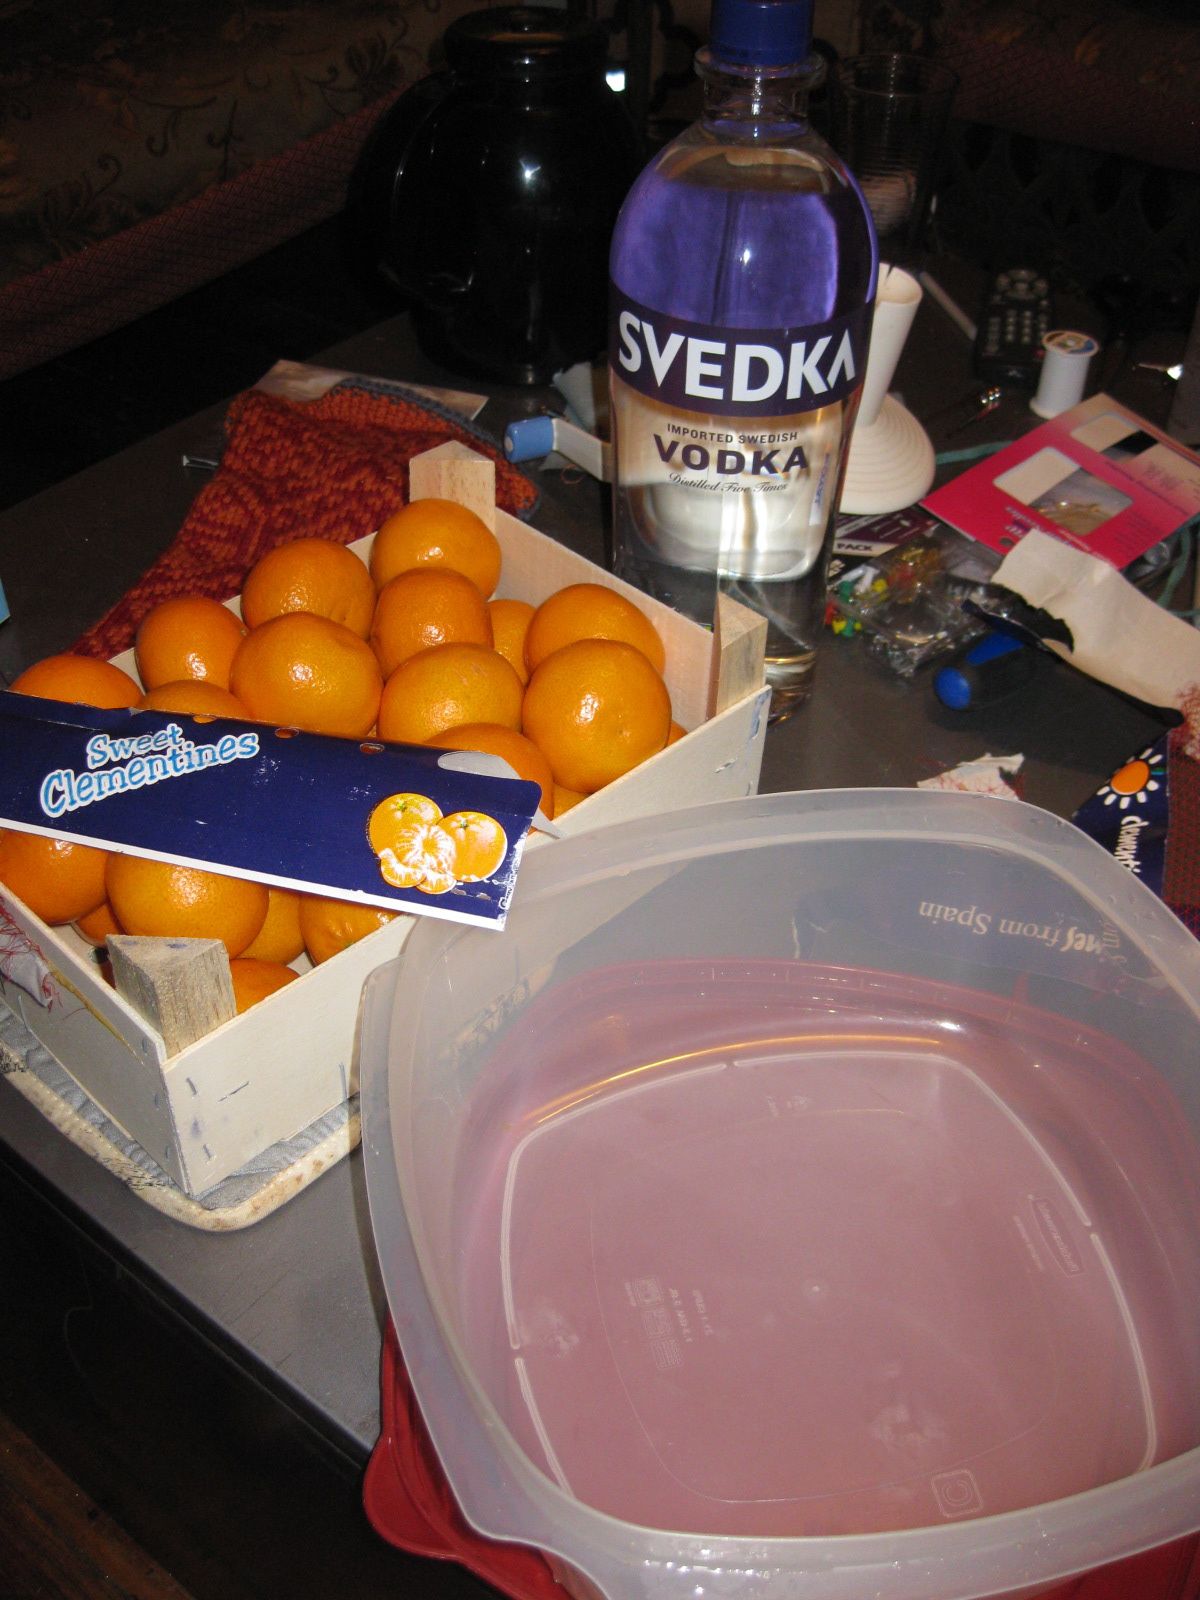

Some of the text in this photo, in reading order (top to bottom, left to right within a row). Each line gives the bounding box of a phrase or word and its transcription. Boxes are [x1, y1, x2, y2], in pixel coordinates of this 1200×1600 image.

[618, 310, 856, 402] SVEDKA
[667, 423, 798, 444] IMPORTED SWEDISH
[653, 433, 809, 475] VODKA
[669, 473, 788, 493] Distilled Five Times
[837, 543, 873, 552] PACK
[87, 724, 185, 768] Sweet
[40, 733, 260, 818] Clementines
[918, 901, 992, 935] Spain
[1000, 918, 1060, 947] from
